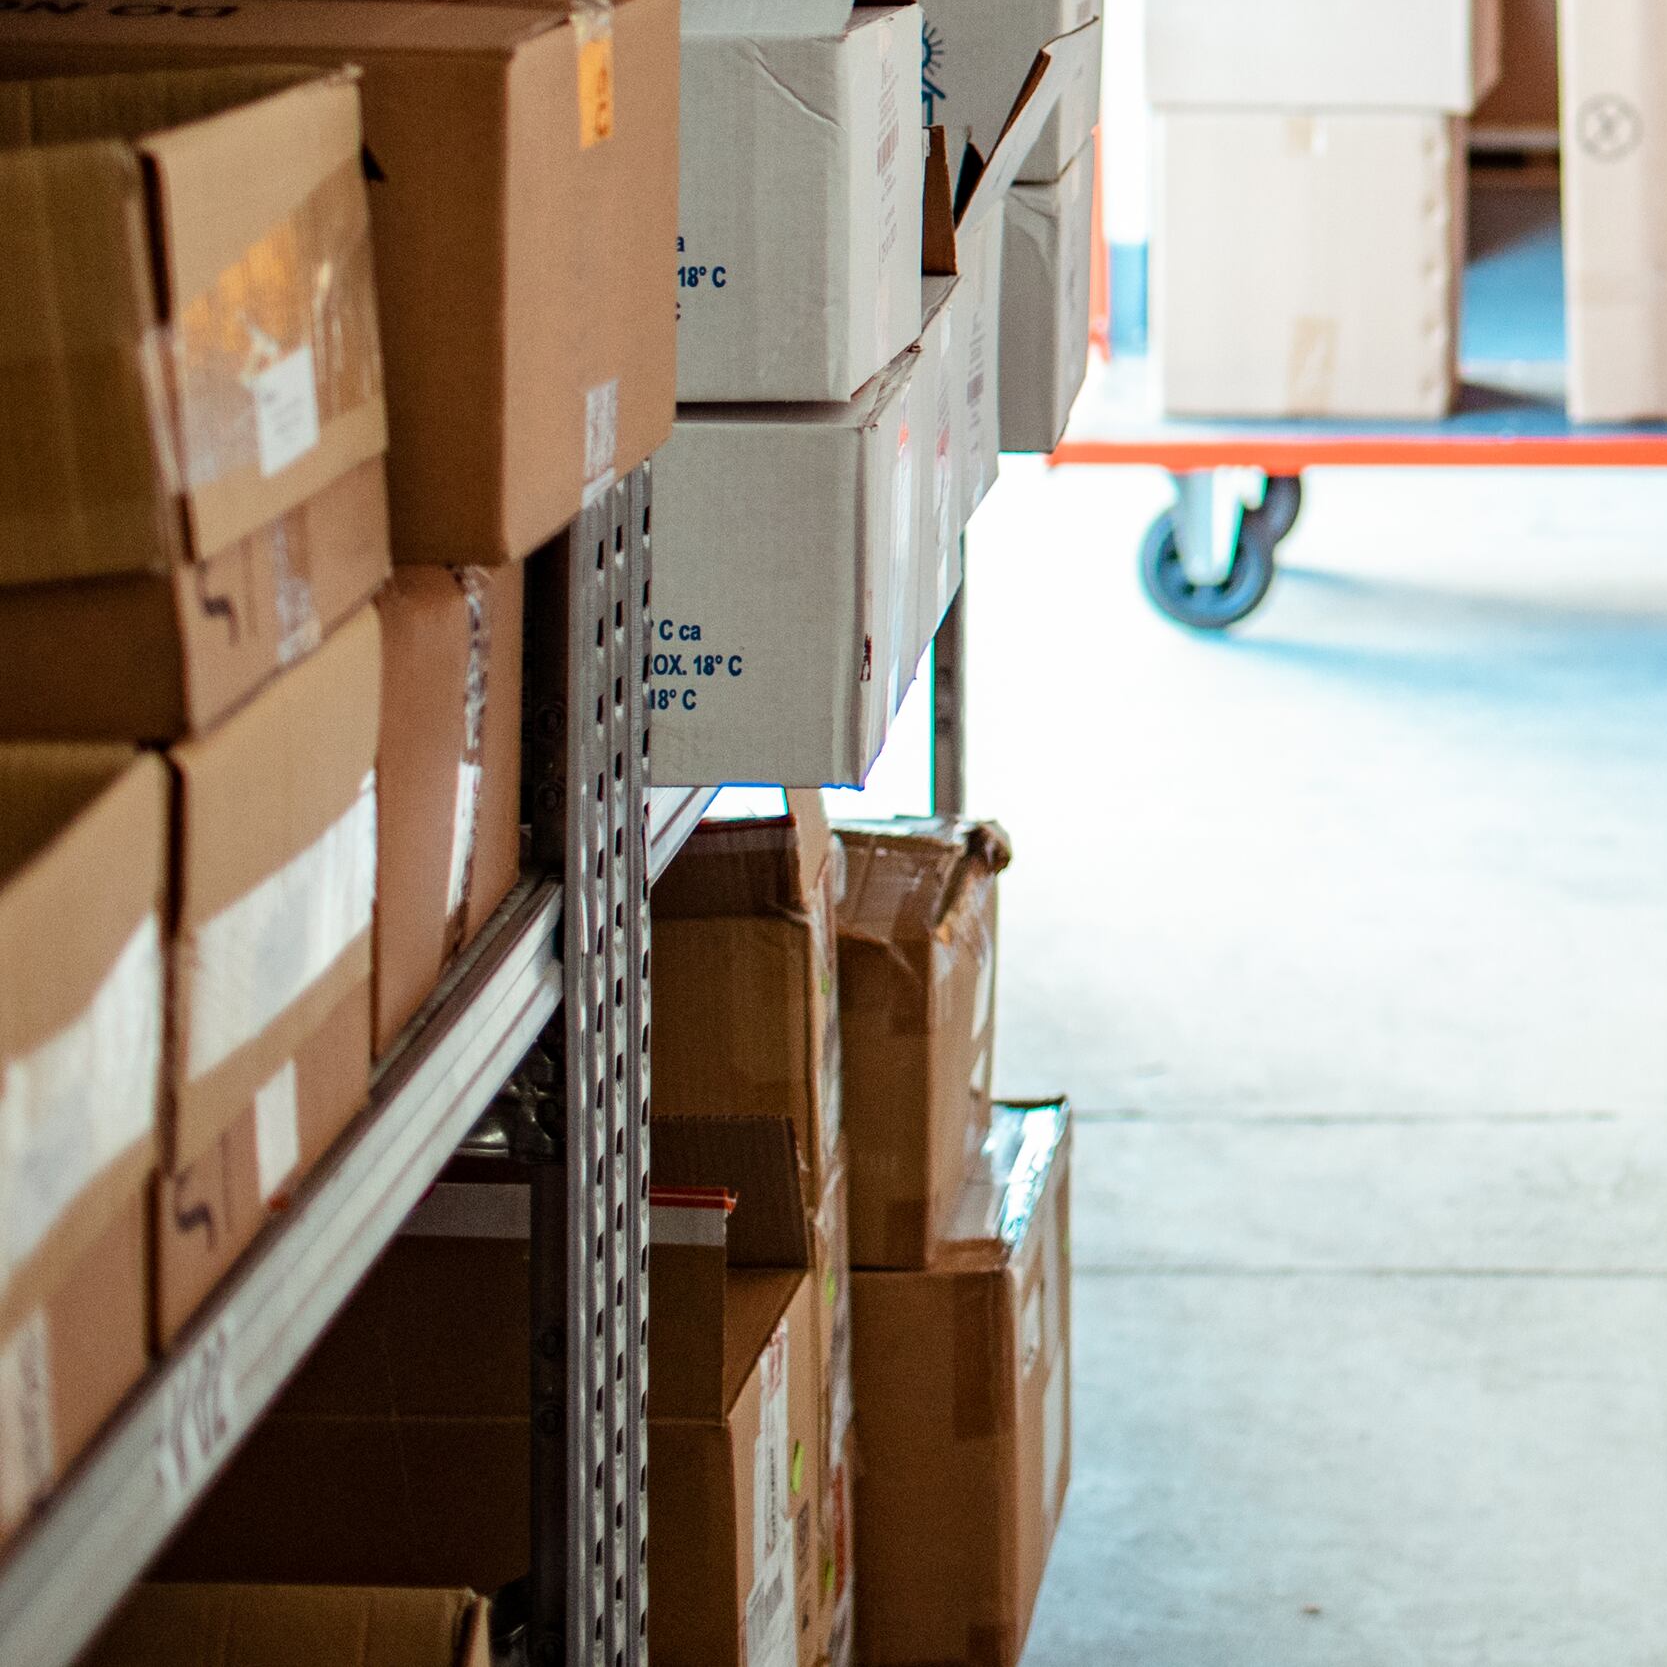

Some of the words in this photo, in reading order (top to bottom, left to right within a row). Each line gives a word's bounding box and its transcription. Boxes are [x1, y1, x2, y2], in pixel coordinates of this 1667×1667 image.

[712, 266, 726, 288] C
[659, 619, 674, 641] C
[678, 624, 702, 641] ca
[650, 654, 687, 676] OX.
[728, 655, 743, 677] C
[682, 689, 697, 710] C
